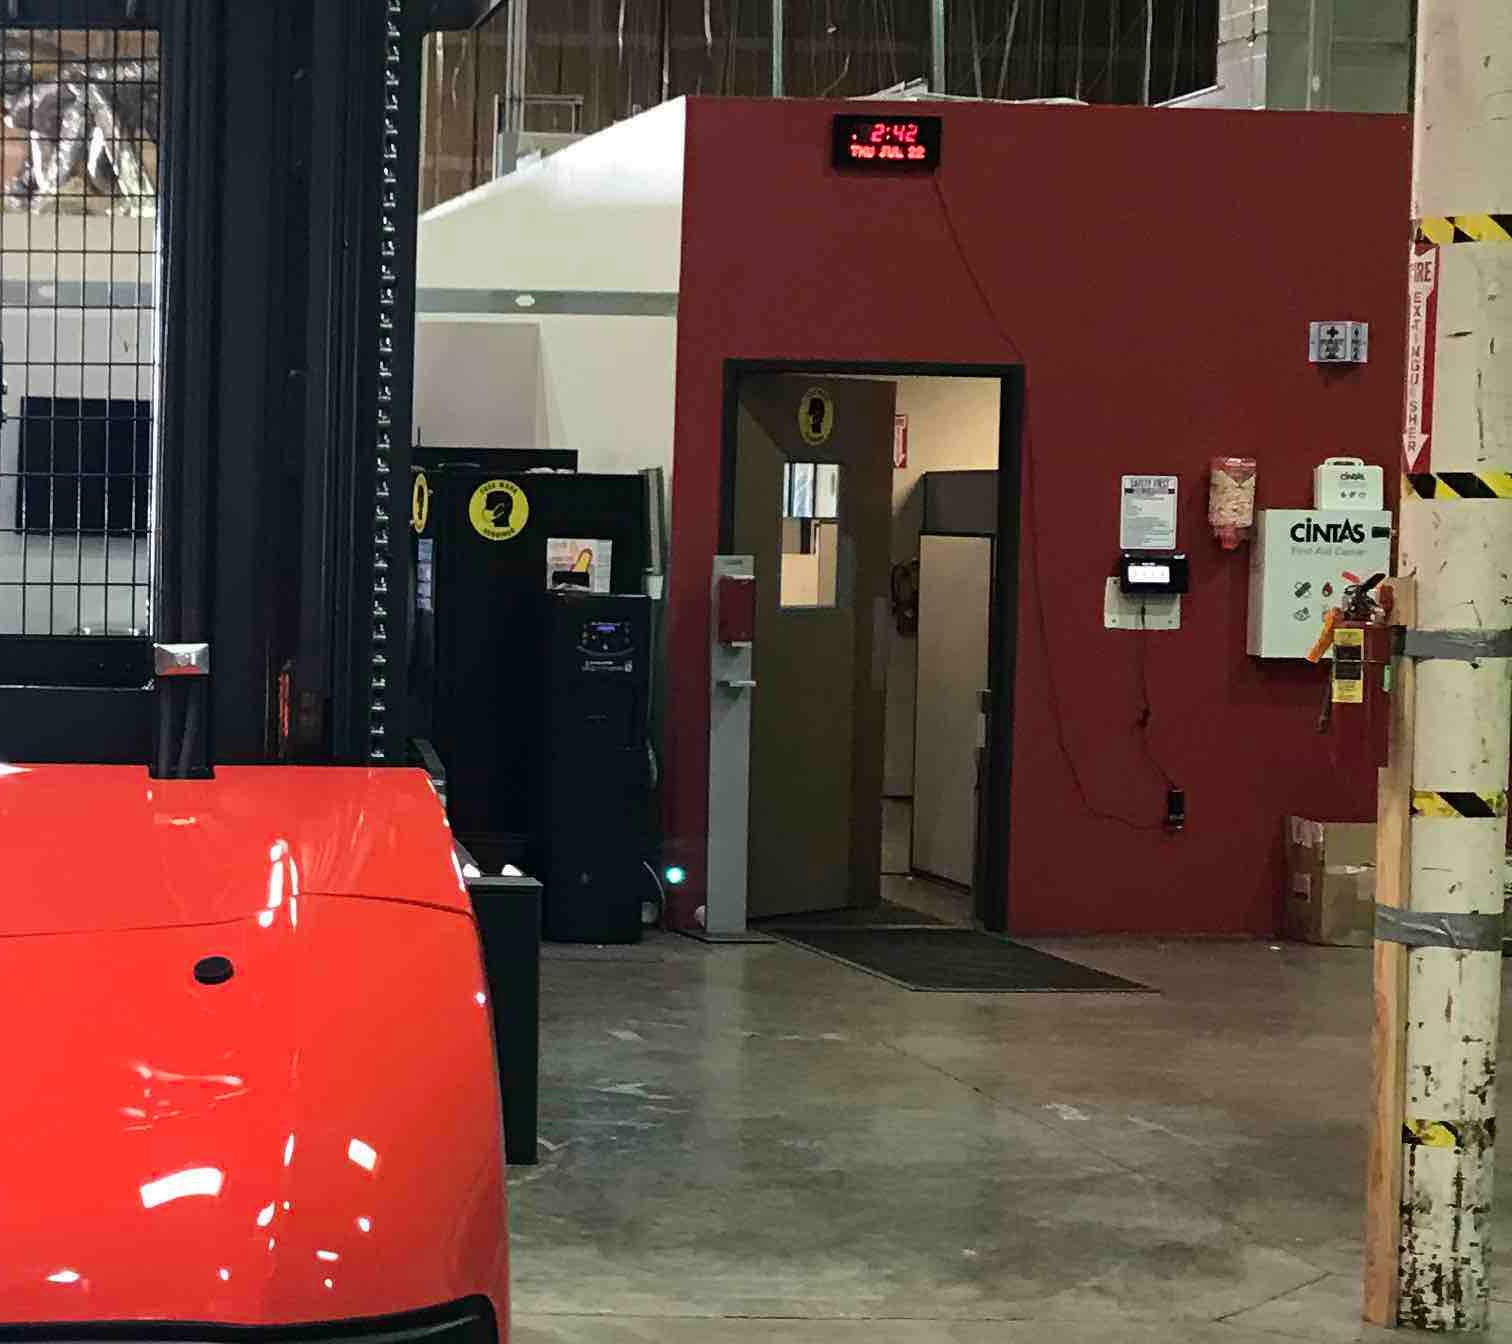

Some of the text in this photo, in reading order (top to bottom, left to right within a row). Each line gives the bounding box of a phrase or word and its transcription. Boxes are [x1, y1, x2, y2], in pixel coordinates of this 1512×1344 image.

[870, 122, 919, 143] 2:42
[907, 144, 926, 159] 22
[1290, 516, 1366, 544] CINTAS
